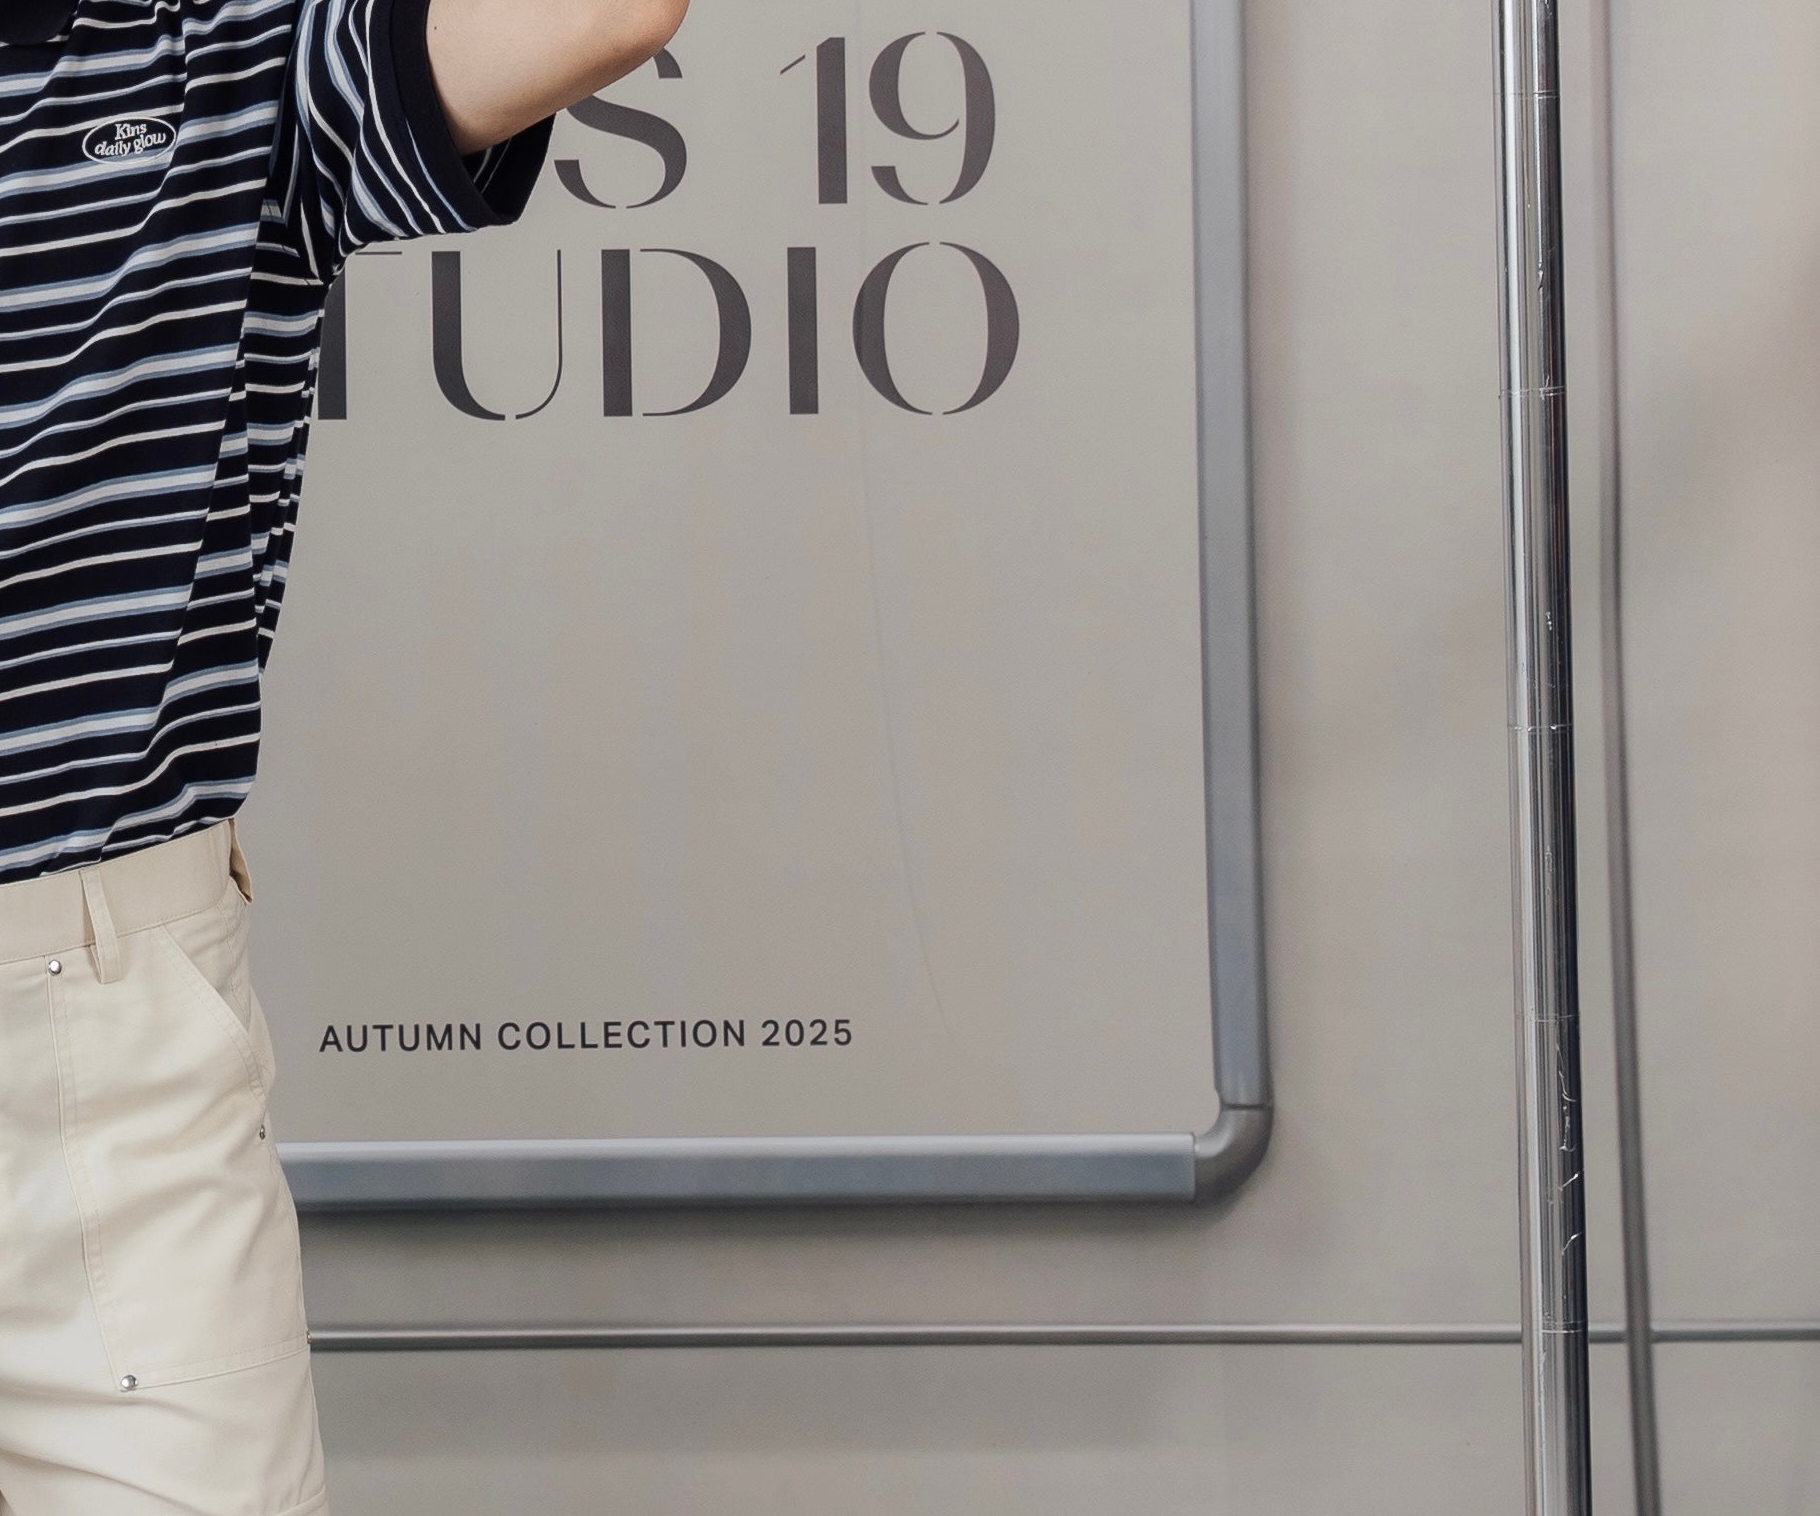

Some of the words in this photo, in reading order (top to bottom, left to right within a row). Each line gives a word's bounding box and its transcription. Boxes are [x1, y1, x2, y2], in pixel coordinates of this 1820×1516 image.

[114, 123, 148, 140] Kins
[780, 31, 996, 206] 19
[94, 141, 132, 156] daily
[133, 132, 167, 154] glow
[317, 241, 1020, 421] TUDIO
[319, 1023, 481, 1053] AUTUMN
[497, 1019, 745, 1051] COLLECTION
[761, 1018, 852, 1047] 2025
